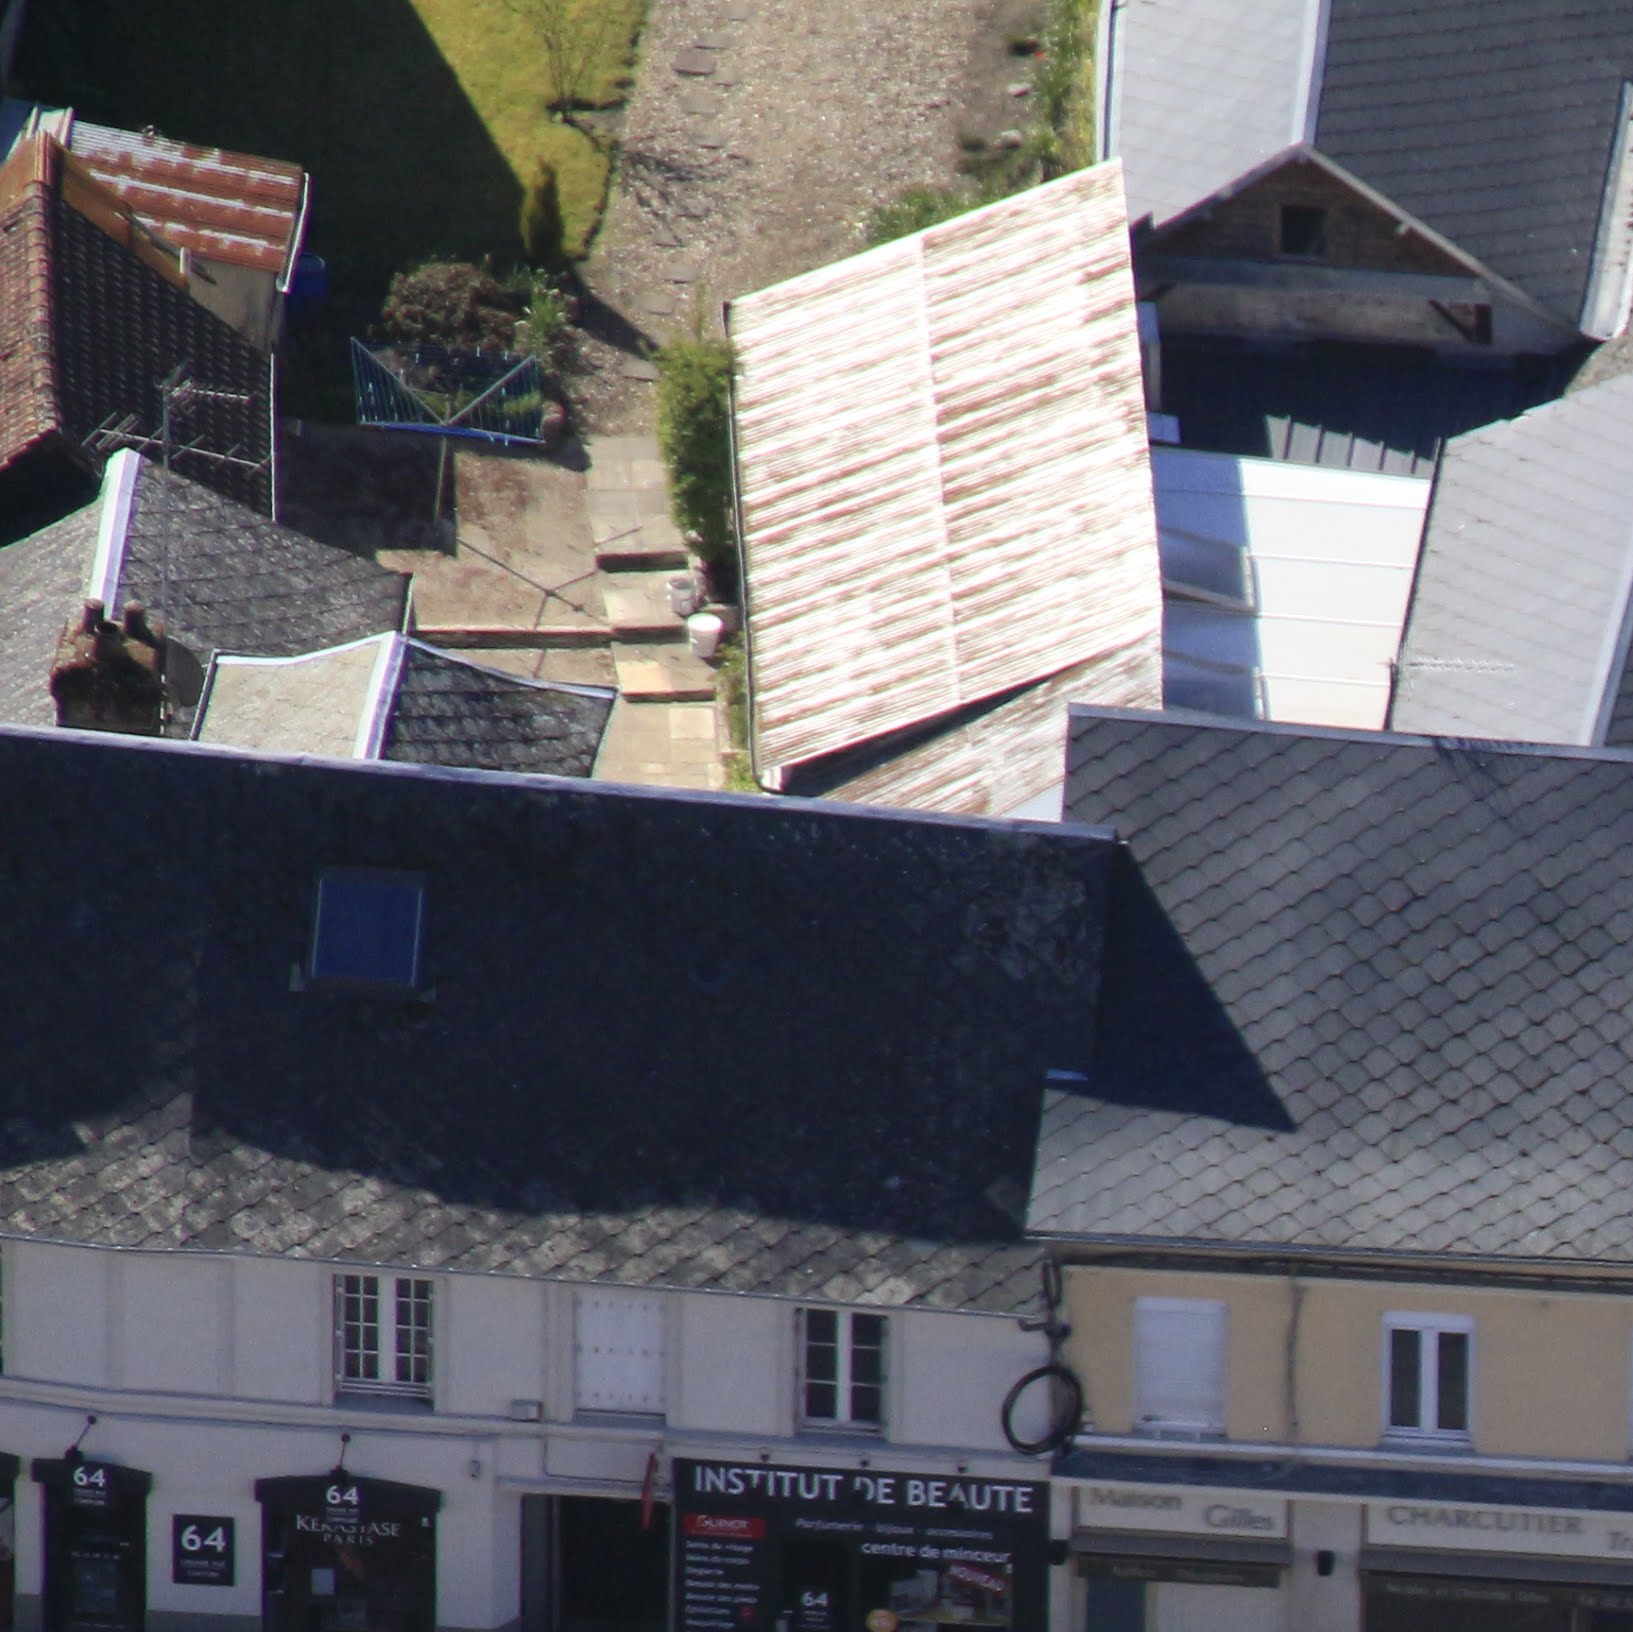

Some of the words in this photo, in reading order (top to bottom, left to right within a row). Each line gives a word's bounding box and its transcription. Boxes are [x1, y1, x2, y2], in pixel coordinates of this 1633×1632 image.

[73, 1466, 106, 1488] 64
[326, 1485, 360, 1505] 64
[695, 1465, 843, 1501] INSTITUT
[852, 1476, 896, 1505] DE
[906, 1478, 1034, 1514] BEAUTE
[1386, 1504, 1584, 1535] CHARCUTIER
[181, 1525, 227, 1553] 64
[323, 1533, 375, 1545] PARIS
[861, 1541, 916, 1557] centre
[919, 1544, 941, 1559] de
[941, 1546, 1013, 1564] minceur
[801, 1591, 829, 1608] 64
